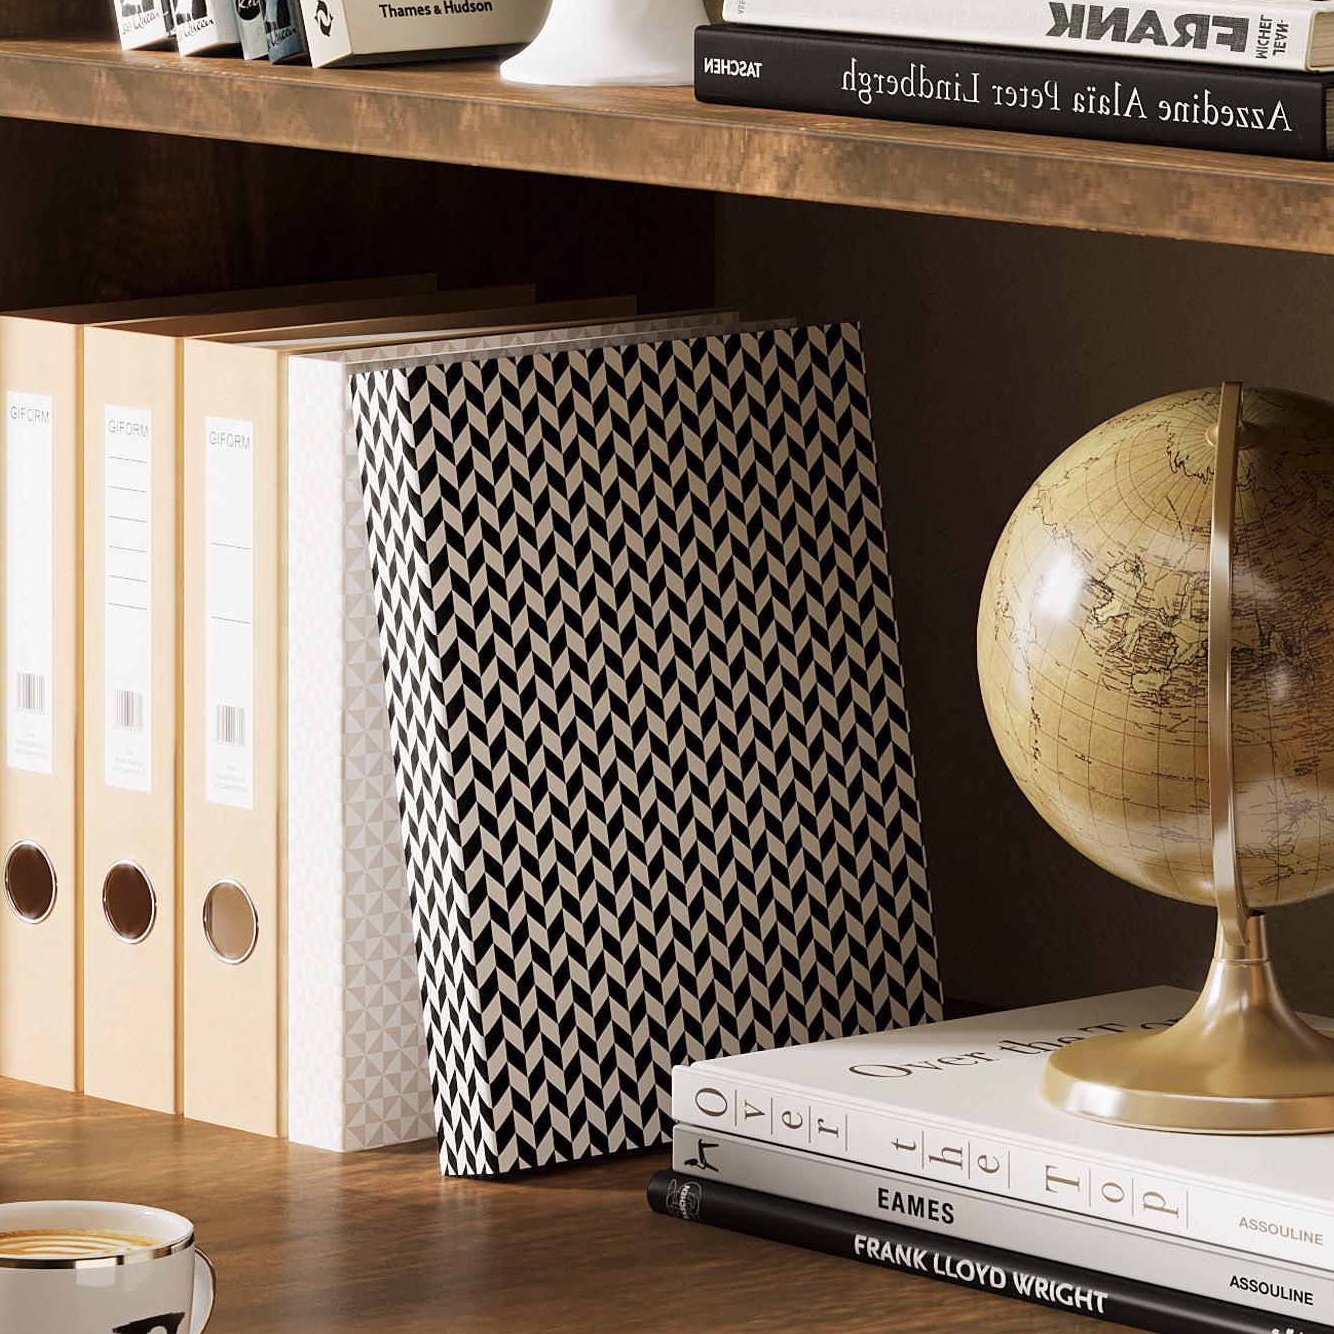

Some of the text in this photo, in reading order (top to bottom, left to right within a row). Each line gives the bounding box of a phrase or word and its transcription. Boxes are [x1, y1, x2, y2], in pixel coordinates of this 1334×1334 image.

[378, 0, 493, 18] Thames & Hudson
[10, 406, 50, 424] GIFORM
[108, 419, 149, 439] GIFORM
[208, 431, 251, 450] GIFORM
[848, 1051, 1000, 1079] Over
[695, 1087, 1179, 1218] Over the Top
[878, 1187, 954, 1224] EAMES
[1238, 1217, 1324, 1246] ASSOULINE
[854, 1233, 1109, 1313] FRANK LLOYD WRIGHT
[1229, 1275, 1314, 1305] ASSOULINE
